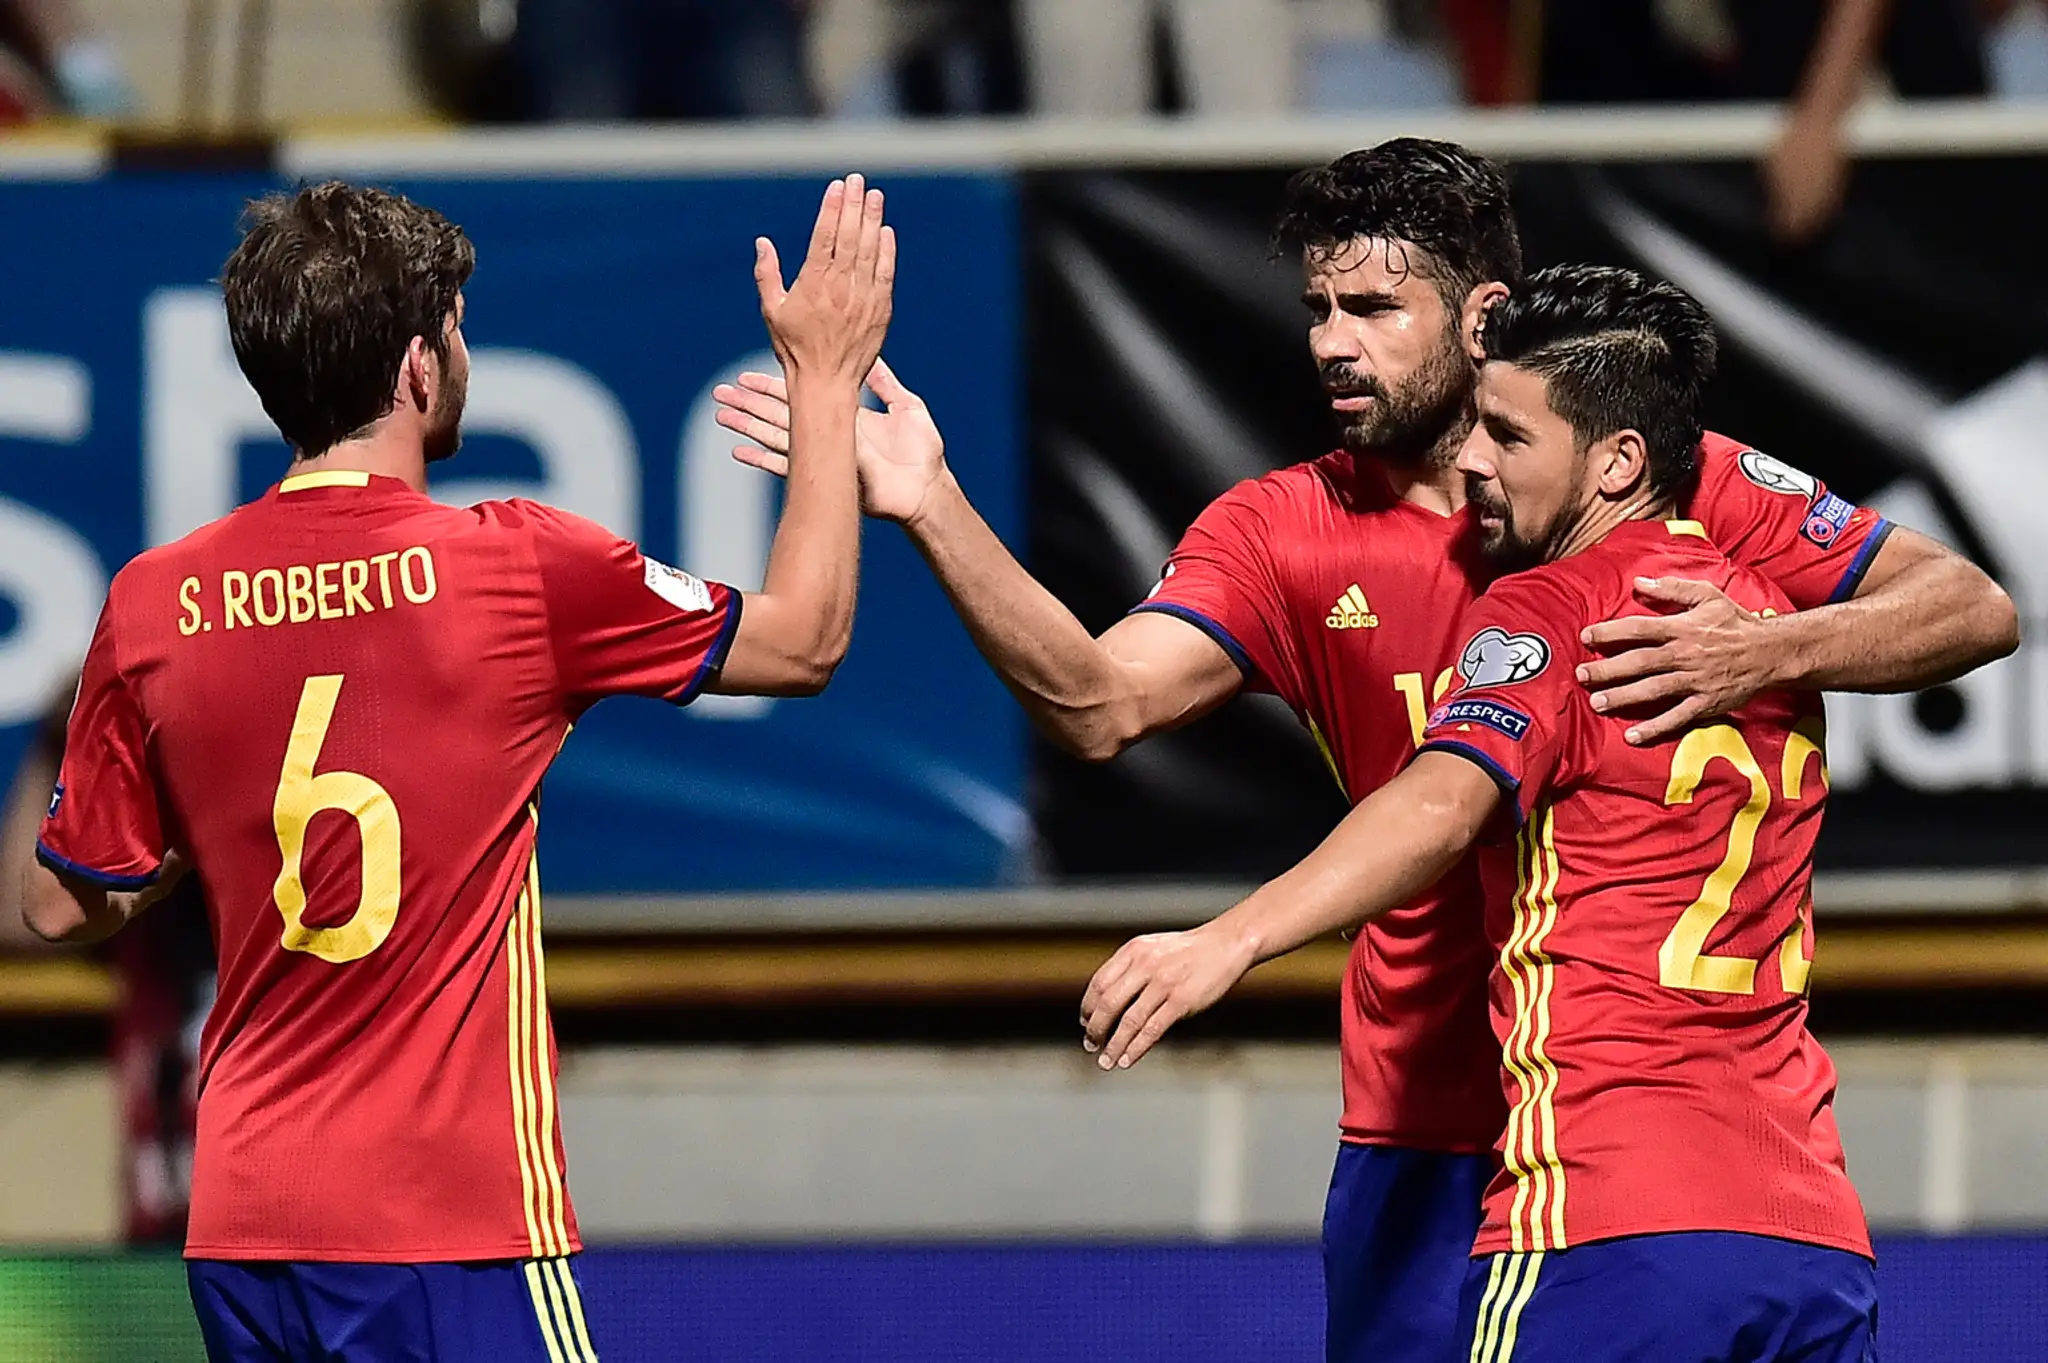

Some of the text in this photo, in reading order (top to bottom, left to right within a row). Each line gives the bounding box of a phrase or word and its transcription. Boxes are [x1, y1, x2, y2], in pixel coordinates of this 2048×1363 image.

[178, 546, 437, 636] S. ROBERTO
[1325, 611, 1379, 629] adidas
[1393, 671, 1455, 750] 1
[1449, 704, 1526, 733] RESPECT
[273, 674, 401, 963] 6
